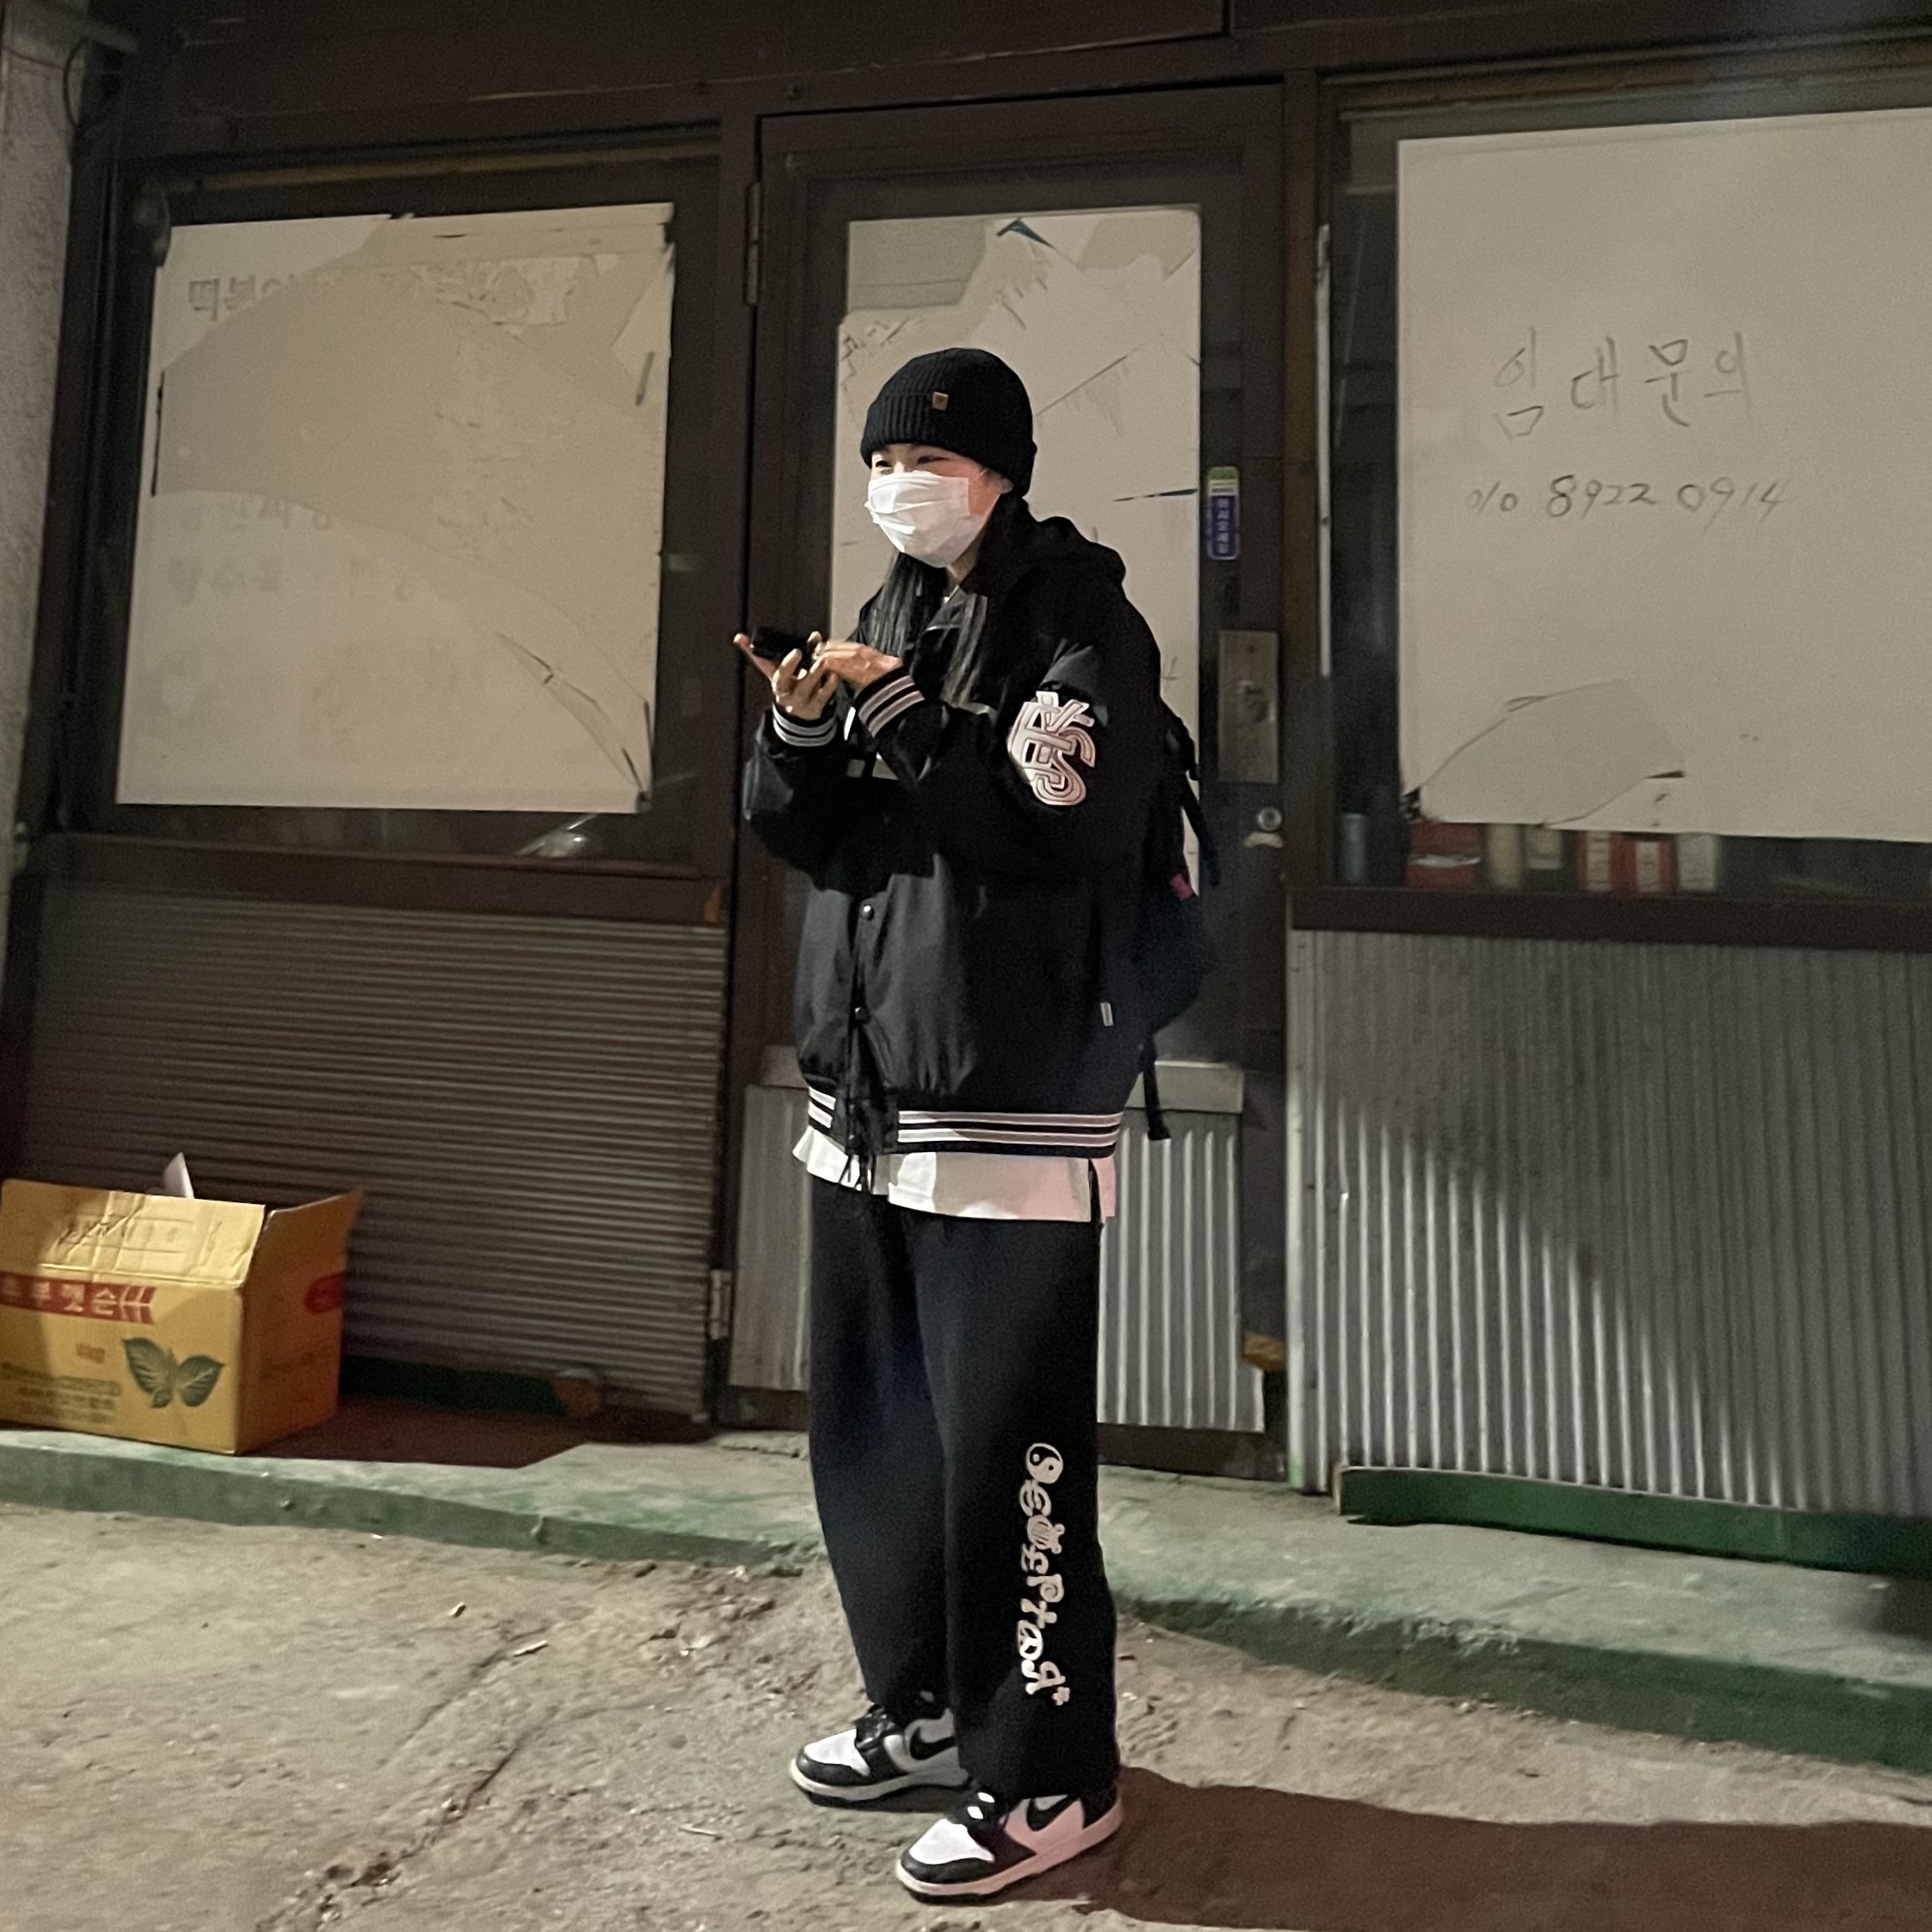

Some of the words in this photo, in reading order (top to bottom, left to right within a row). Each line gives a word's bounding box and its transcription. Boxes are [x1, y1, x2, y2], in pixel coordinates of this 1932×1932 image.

[1493, 326, 1751, 440] 임대문의
[1545, 474, 1661, 521] 8922
[1676, 476, 1785, 531] 0914
